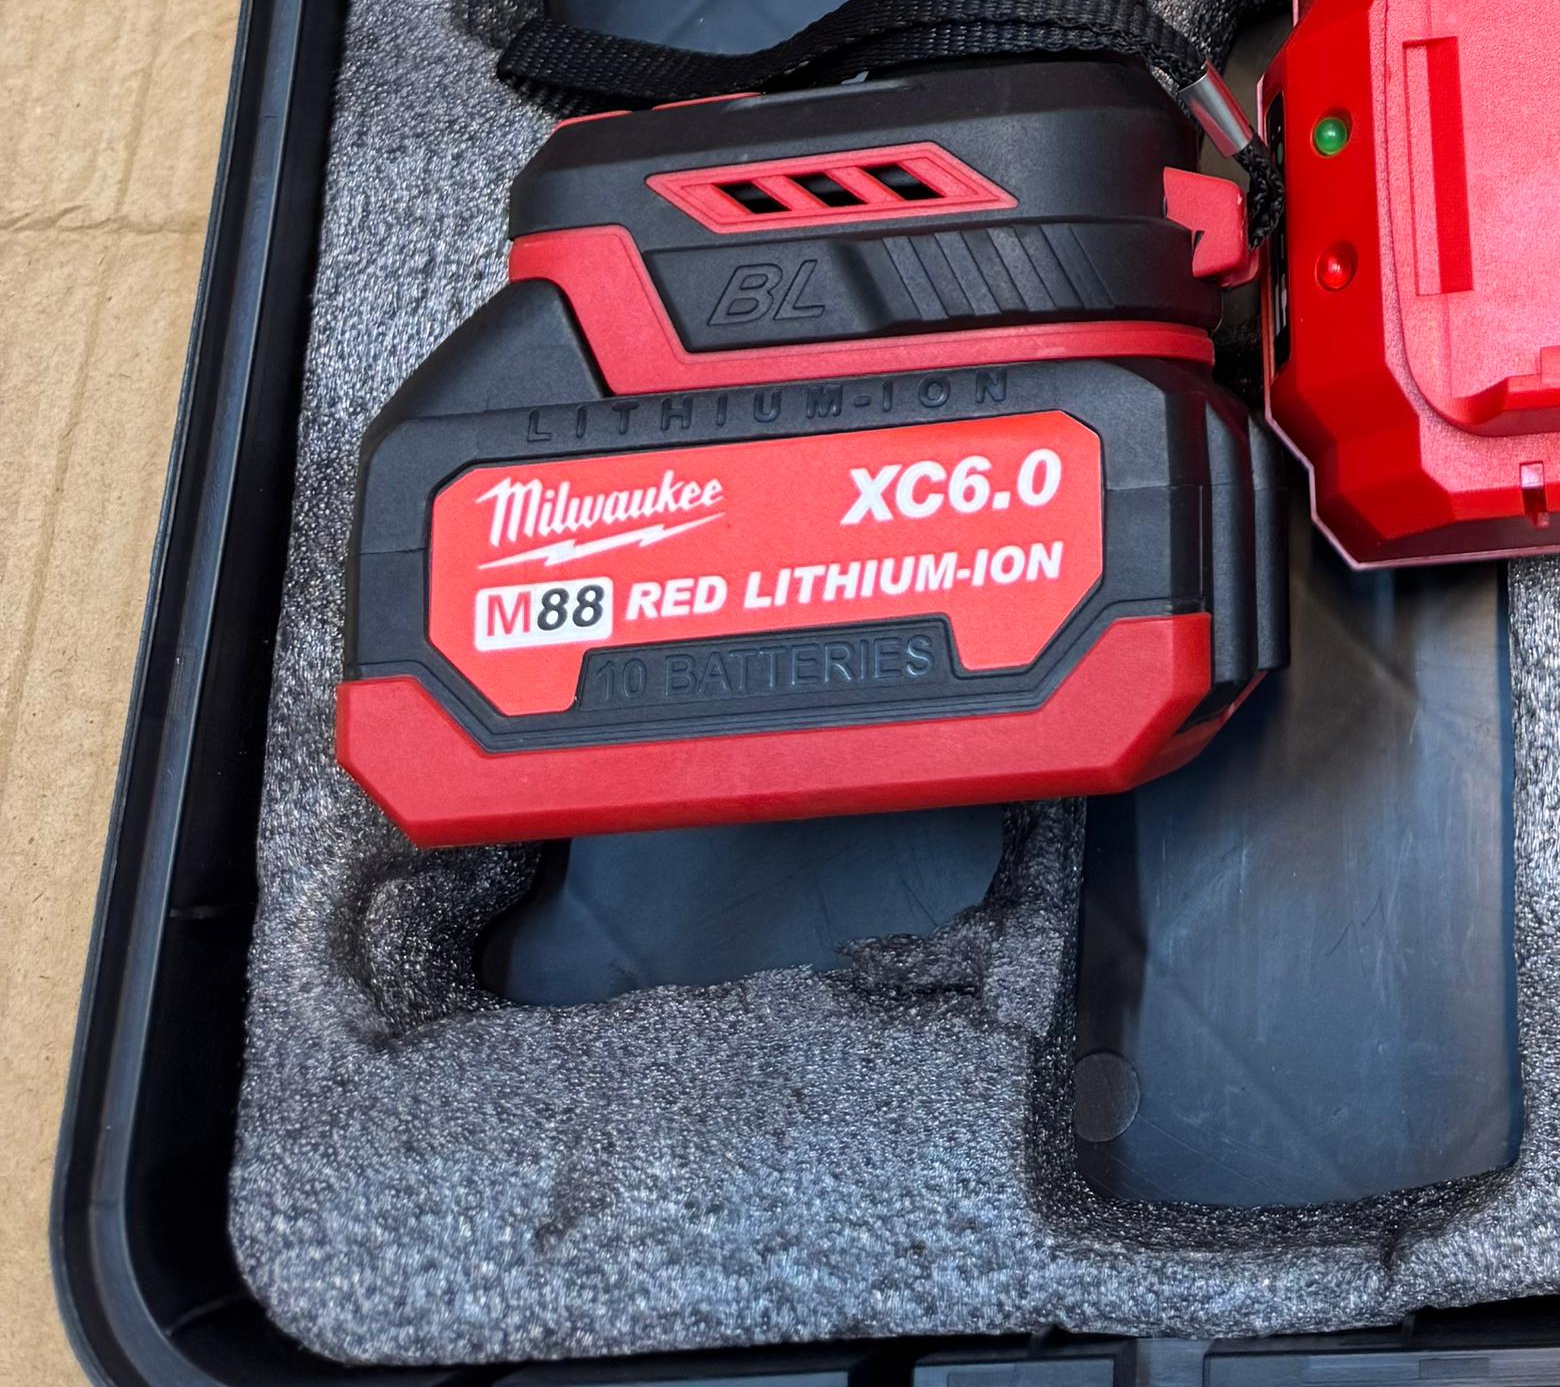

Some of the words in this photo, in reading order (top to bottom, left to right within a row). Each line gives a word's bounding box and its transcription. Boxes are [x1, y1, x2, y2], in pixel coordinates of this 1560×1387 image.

[707, 259, 828, 327] BL
[526, 371, 1009, 443] LITHIUM-ION
[475, 469, 725, 548] Milwaukee
[840, 448, 1063, 526] XC6.0
[486, 584, 605, 637] M88
[624, 575, 728, 621] RED
[743, 540, 1064, 609] LITHIUM-ION
[597, 657, 648, 701] 10
[663, 634, 935, 698] BATTERIES
